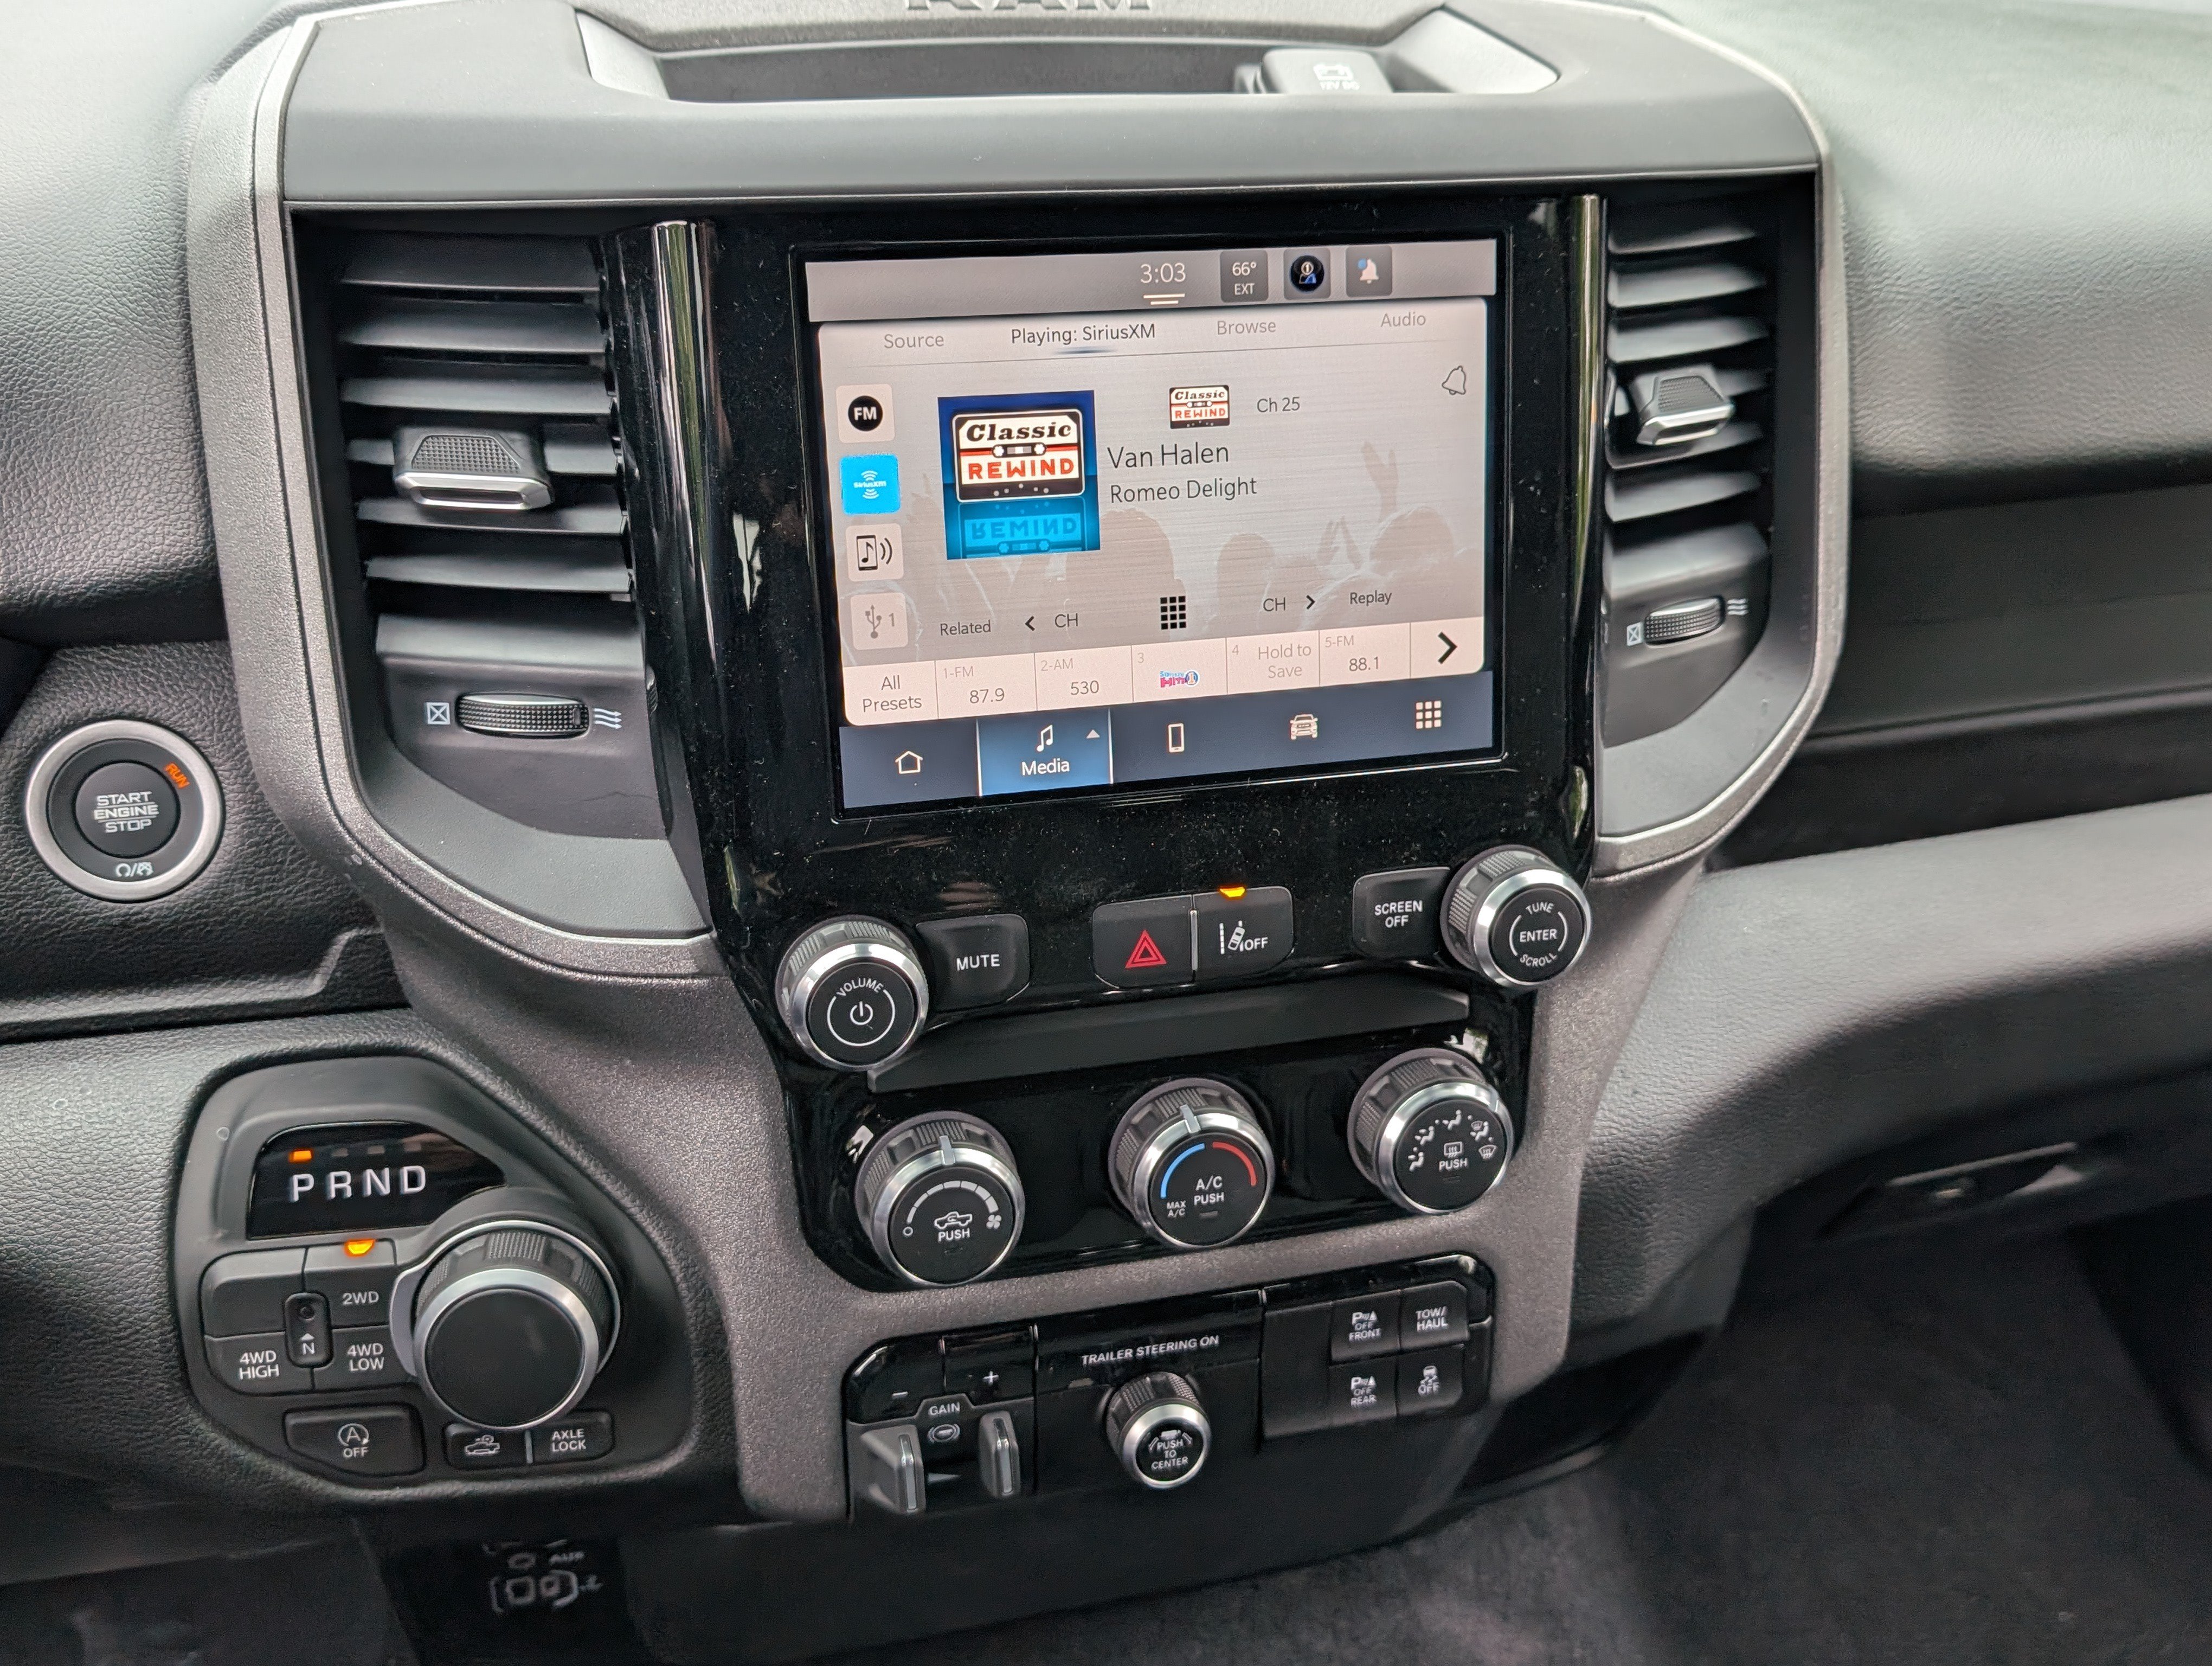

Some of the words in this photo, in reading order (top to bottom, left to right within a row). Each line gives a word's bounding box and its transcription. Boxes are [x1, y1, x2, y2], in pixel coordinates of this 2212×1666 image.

[1140, 262, 1186, 283] 3:03
[1234, 283, 1255, 296] EXT
[1217, 319, 1276, 336] Browse
[1380, 312, 1426, 328] Audio
[884, 333, 944, 349] Source
[1011, 326, 1078, 347] Playing:
[1083, 323, 1156, 342] SiriusXM
[1174, 389, 1225, 401] Classic
[1257, 398, 1277, 413] Ch
[1282, 396, 1301, 412] 25
[854, 407, 877, 421] FM
[1175, 408, 1226, 419] REWIND
[966, 421, 1072, 442] Classic
[1107, 446, 1153, 469] Van
[1161, 441, 1229, 466] Halen
[968, 457, 1075, 480] REWIND
[1111, 484, 1180, 503] Romeo
[1187, 477, 1257, 501] Delight
[1263, 598, 1287, 612] CH
[1350, 589, 1392, 606] Replay
[888, 613, 896, 627] 1
[1054, 613, 1079, 629] CH
[940, 620, 992, 637] Related
[1325, 636, 1354, 649] 5-FM
[1137, 652, 1144, 663] 3
[1232, 645, 1239, 656] 4
[1258, 644, 1294, 660] Hold
[1297, 643, 1312, 656] to
[1040, 658, 1073, 671] 2-AM
[1349, 657, 1380, 671] 88.1
[943, 666, 974, 679] 1-FM
[1268, 665, 1302, 679] Save
[881, 675, 901, 690] All
[1070, 680, 1099, 696] 530
[969, 688, 1005, 704] 87.9
[863, 696, 922, 713] Presets
[1021, 758, 1070, 776] Media
[165, 762, 190, 788] RUN
[97, 791, 152, 805] START
[93, 804, 159, 821] ENGINE
[104, 818, 152, 834] STOP
[1374, 900, 1423, 917] SCREEN
[1525, 901, 1555, 915] TUNE
[1385, 914, 1409, 928] OFF
[1519, 928, 1557, 943] ENTER
[1244, 936, 1269, 951] OFF
[956, 953, 1001, 971] MUTE
[1520, 952, 1558, 967] SCROLL
[835, 977, 884, 998] VOLUME
[1438, 1158, 1468, 1171] PUSH
[1195, 1175, 1223, 1192] A/C
[1166, 1200, 1187, 1209] MAX
[1194, 1192, 1225, 1206] PUSH
[1167, 1208, 1186, 1218] A/C
[937, 1228, 970, 1242] PUSH
[342, 1290, 380, 1306] 2WD
[1416, 1306, 1448, 1321] TOW/
[1355, 1321, 1375, 1331] OFF
[1416, 1317, 1449, 1332] HAUL
[1349, 1328, 1381, 1342] FRONT
[302, 1342, 315, 1356] N
[346, 1342, 384, 1357] 4WD
[1082, 1348, 1134, 1367] TRAILER
[1136, 1338, 1198, 1357] STEERING
[1199, 1335, 1220, 1347] ON
[239, 1350, 277, 1364] 4WD
[349, 1356, 384, 1372] LOW
[239, 1363, 280, 1380] HIGH
[1353, 1386, 1372, 1396] OFF
[1418, 1382, 1439, 1396] OFF
[928, 1401, 961, 1416] GAIN
[1351, 1394, 1377, 1408] REAR
[551, 1428, 585, 1440] AXLE
[343, 1445, 370, 1458] OFF
[551, 1439, 587, 1453] LOCK
[1156, 1438, 1184, 1451] PUSH
[1163, 1449, 1177, 1459] TO
[1150, 1456, 1189, 1471] CENTER
